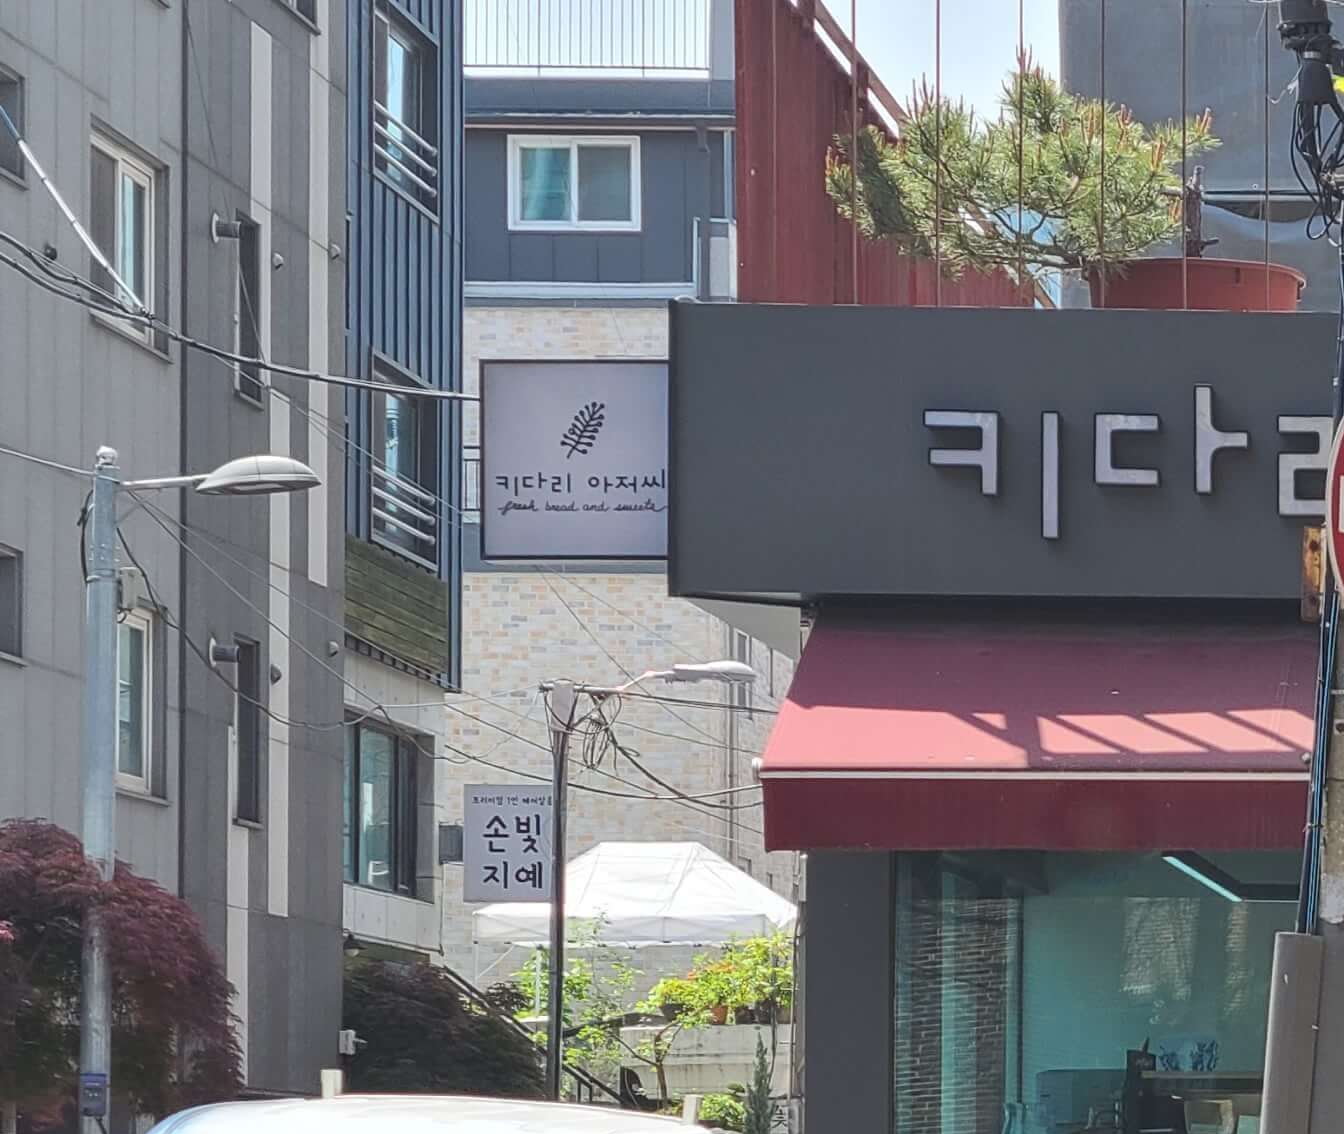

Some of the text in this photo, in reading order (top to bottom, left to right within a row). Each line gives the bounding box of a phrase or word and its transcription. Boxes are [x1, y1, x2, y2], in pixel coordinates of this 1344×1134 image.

[496, 467, 666, 497] 키다리 아저씨
[498, 498, 668, 516] fresh bread and sweets
[482, 814, 541, 854] 손빛
[483, 860, 542, 890] 지예
